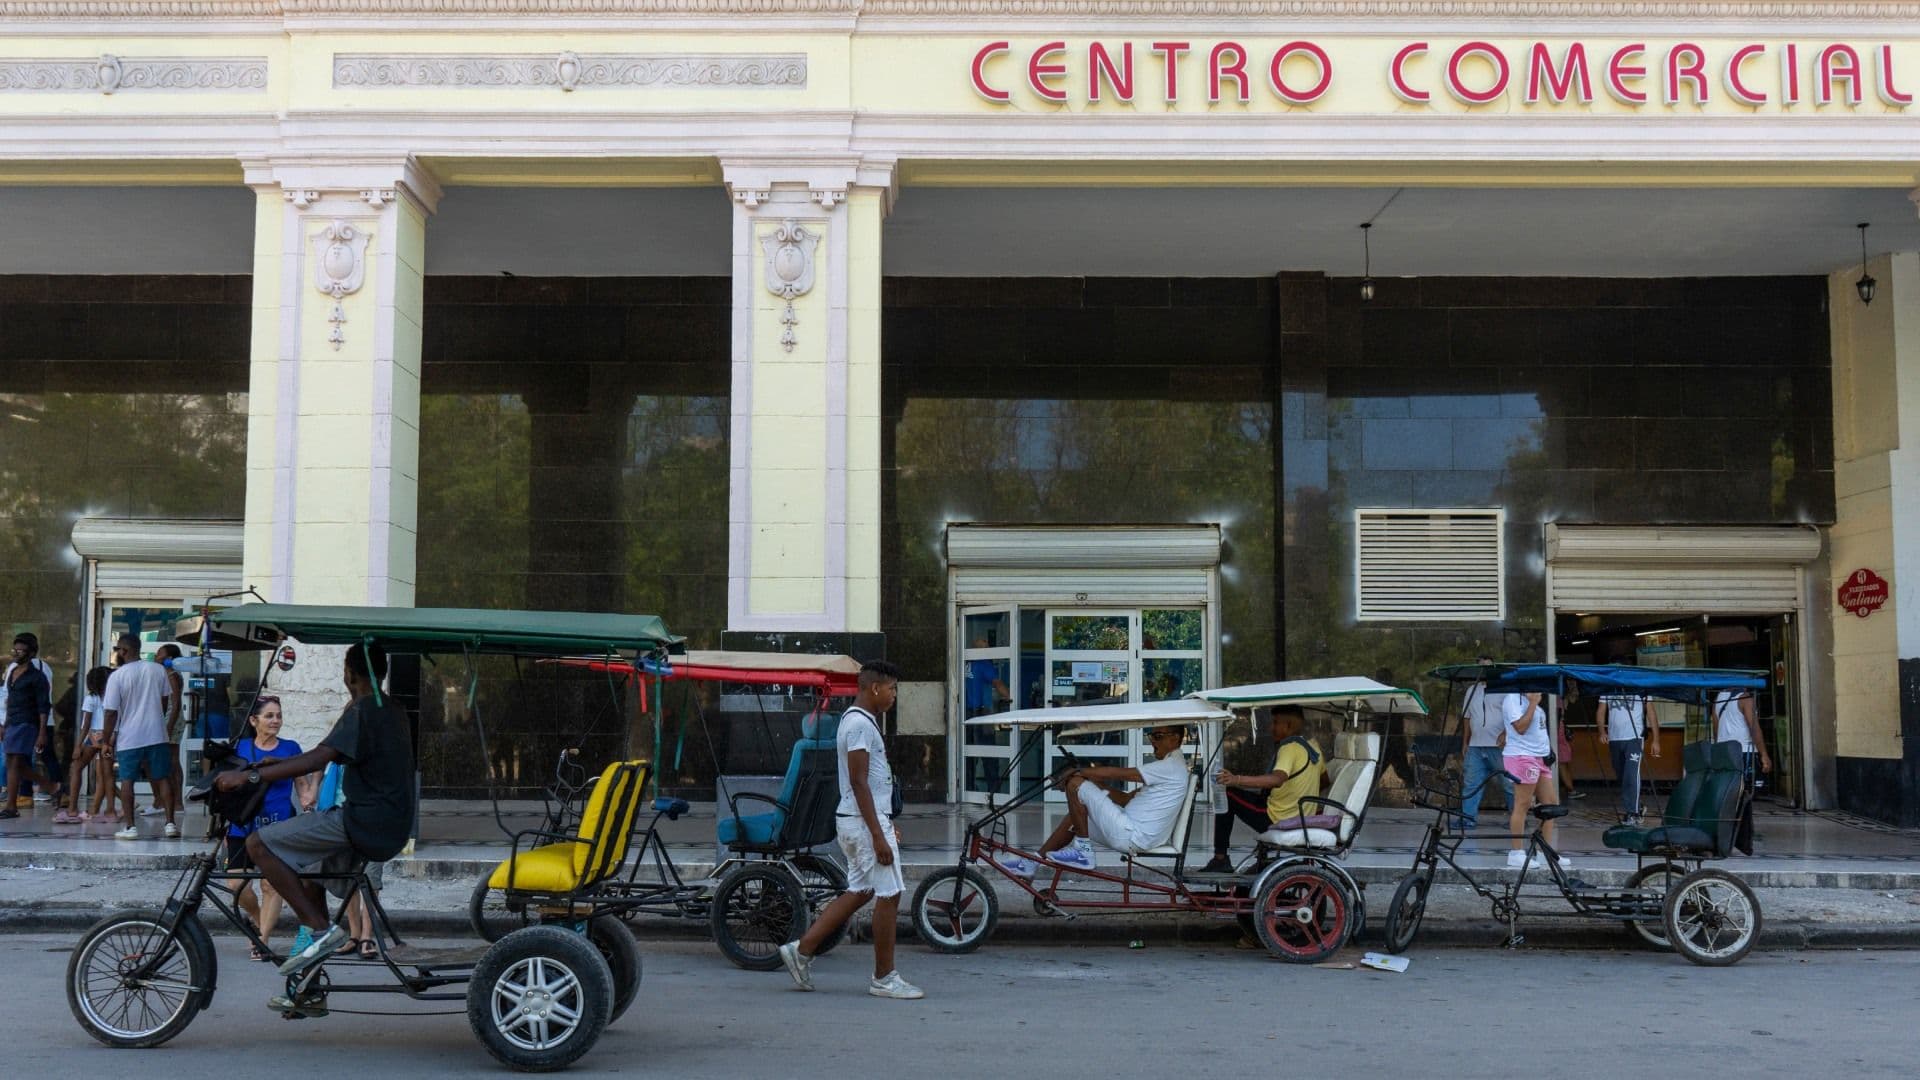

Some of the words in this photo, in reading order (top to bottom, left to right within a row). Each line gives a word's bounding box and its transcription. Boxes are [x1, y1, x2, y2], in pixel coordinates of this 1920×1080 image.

[970, 40, 1334, 104] CENTRO
[1389, 41, 1914, 104] COMERCIAL
[1841, 590, 1885, 607] Galiano
